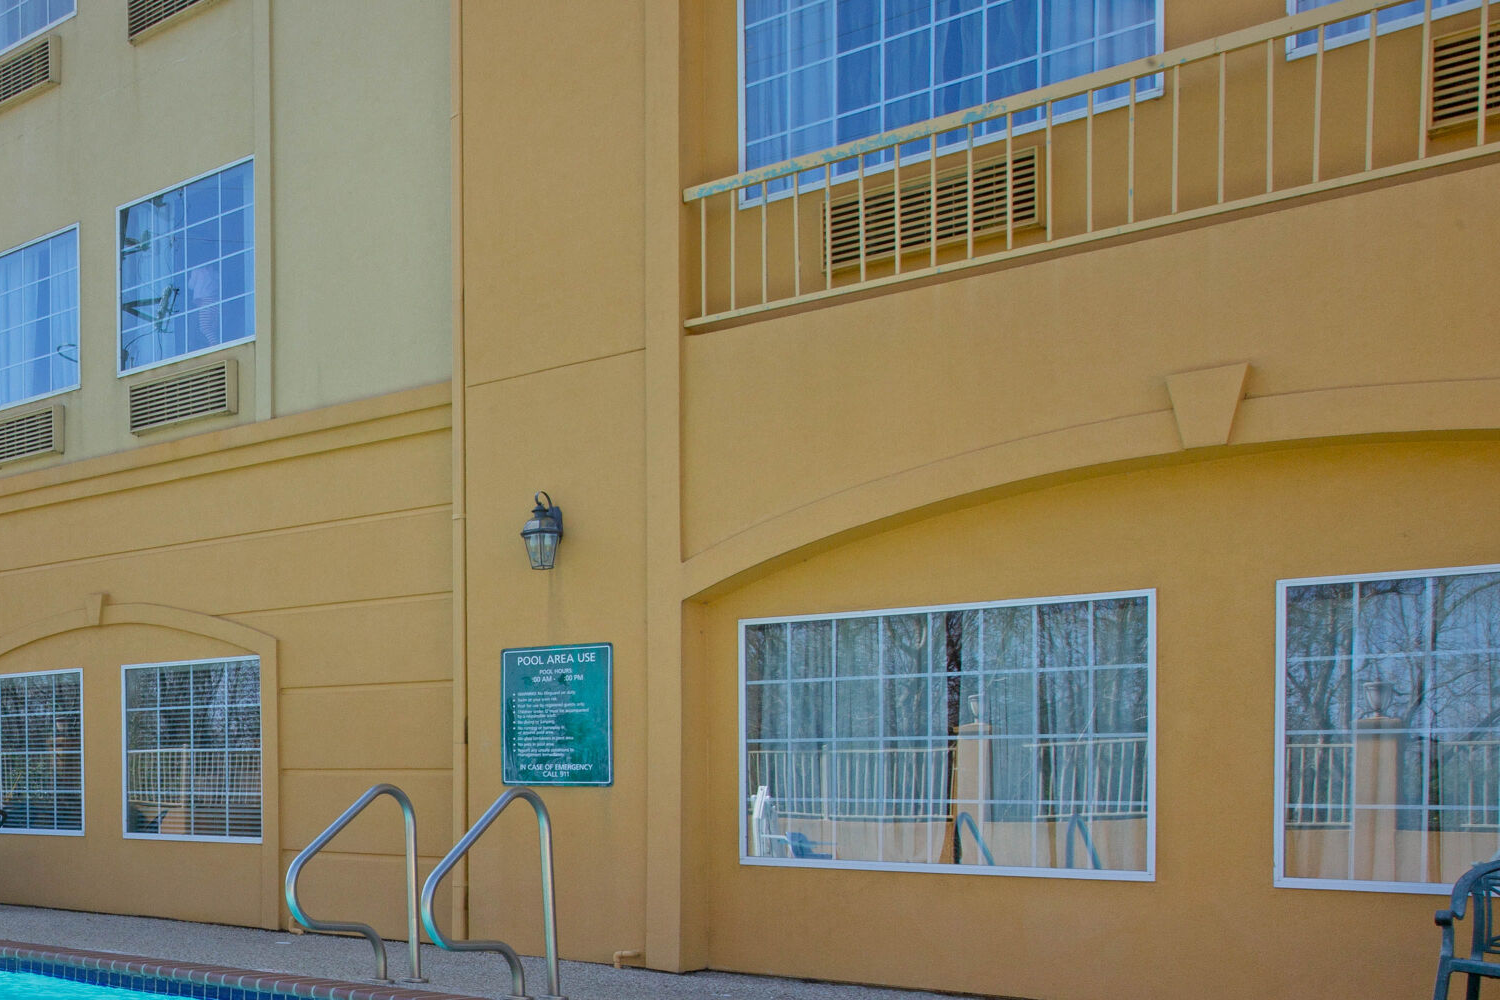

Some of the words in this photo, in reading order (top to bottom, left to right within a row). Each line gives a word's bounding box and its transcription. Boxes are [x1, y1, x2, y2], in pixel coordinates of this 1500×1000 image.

[517, 655, 544, 666] POOL
[547, 653, 574, 664] AREA
[577, 652, 596, 663] USE
